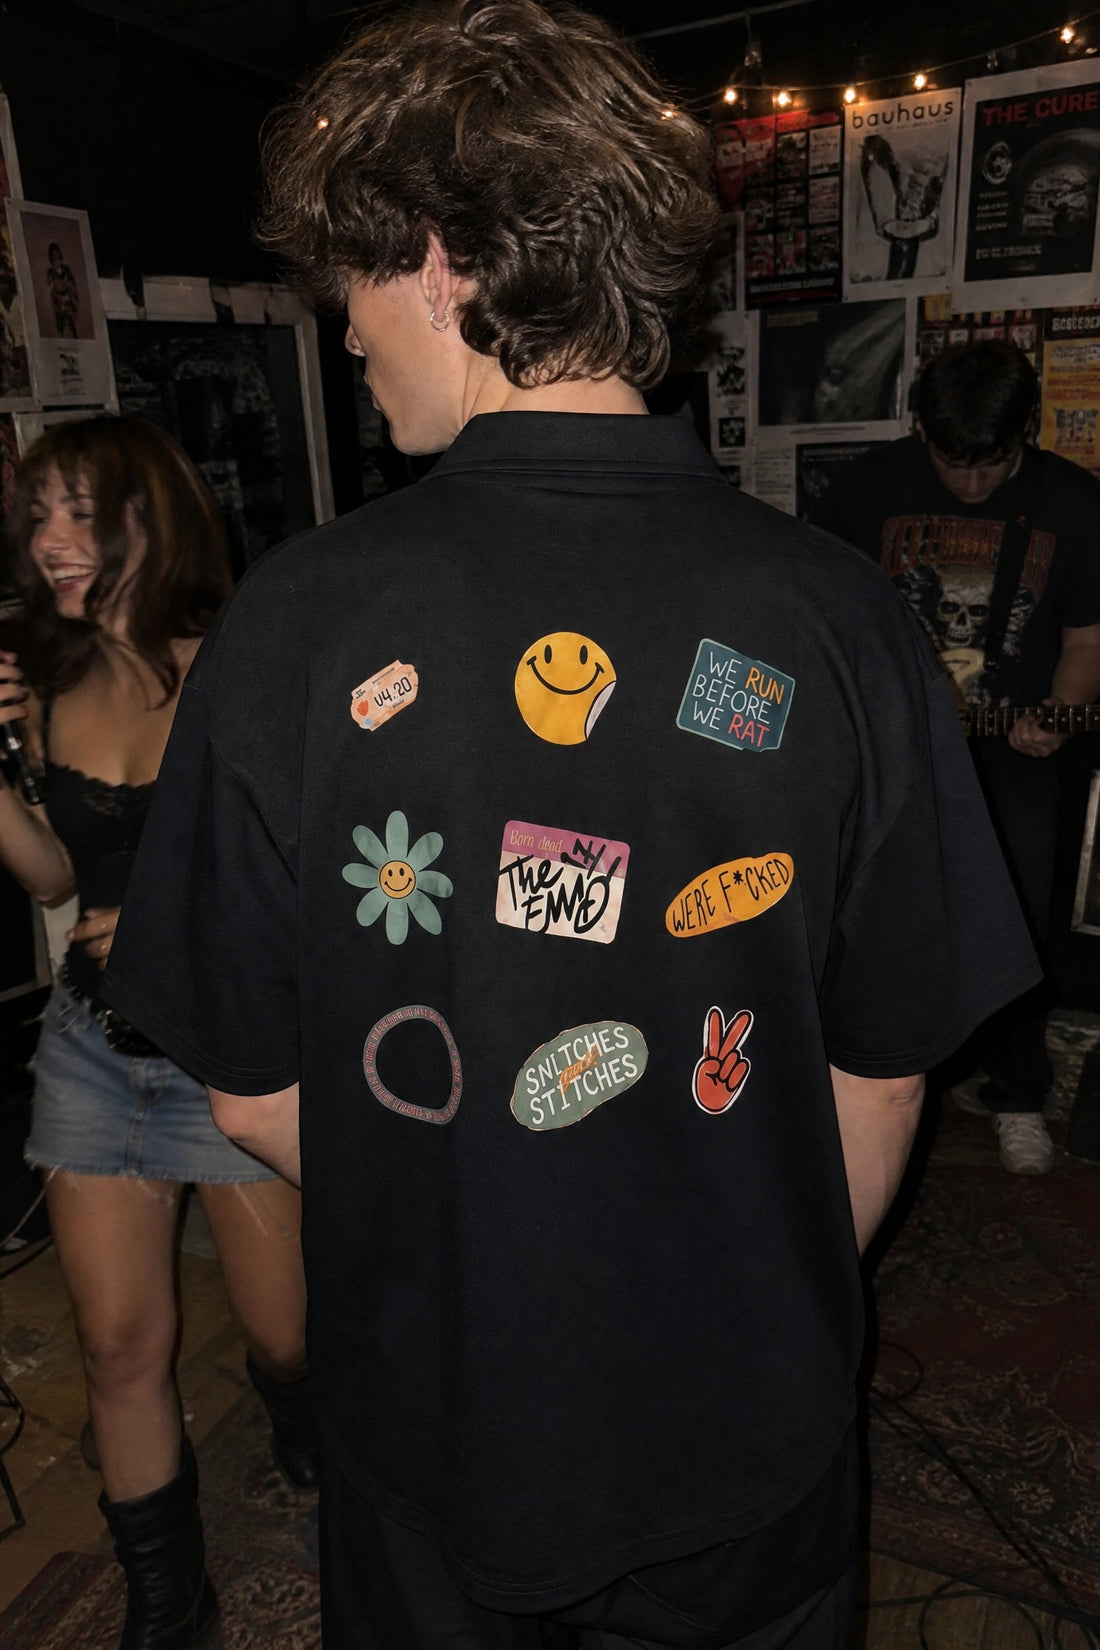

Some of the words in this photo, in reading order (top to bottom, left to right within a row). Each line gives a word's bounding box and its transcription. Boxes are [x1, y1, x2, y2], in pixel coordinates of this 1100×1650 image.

[852, 101, 954, 129] bauhaus
[981, 100, 1029, 128] THE
[1034, 90, 1100, 119] CURE
[692, 674, 772, 724] BEFORE
[709, 651, 742, 684] WE
[745, 667, 785, 705] RUN
[693, 701, 724, 731] WE
[728, 713, 770, 747] RAT
[510, 829, 534, 848] Born
[538, 836, 563, 853] dead
[499, 854, 564, 911] The
[673, 879, 716, 932] WERE
[530, 1053, 638, 1125] STITCHES
